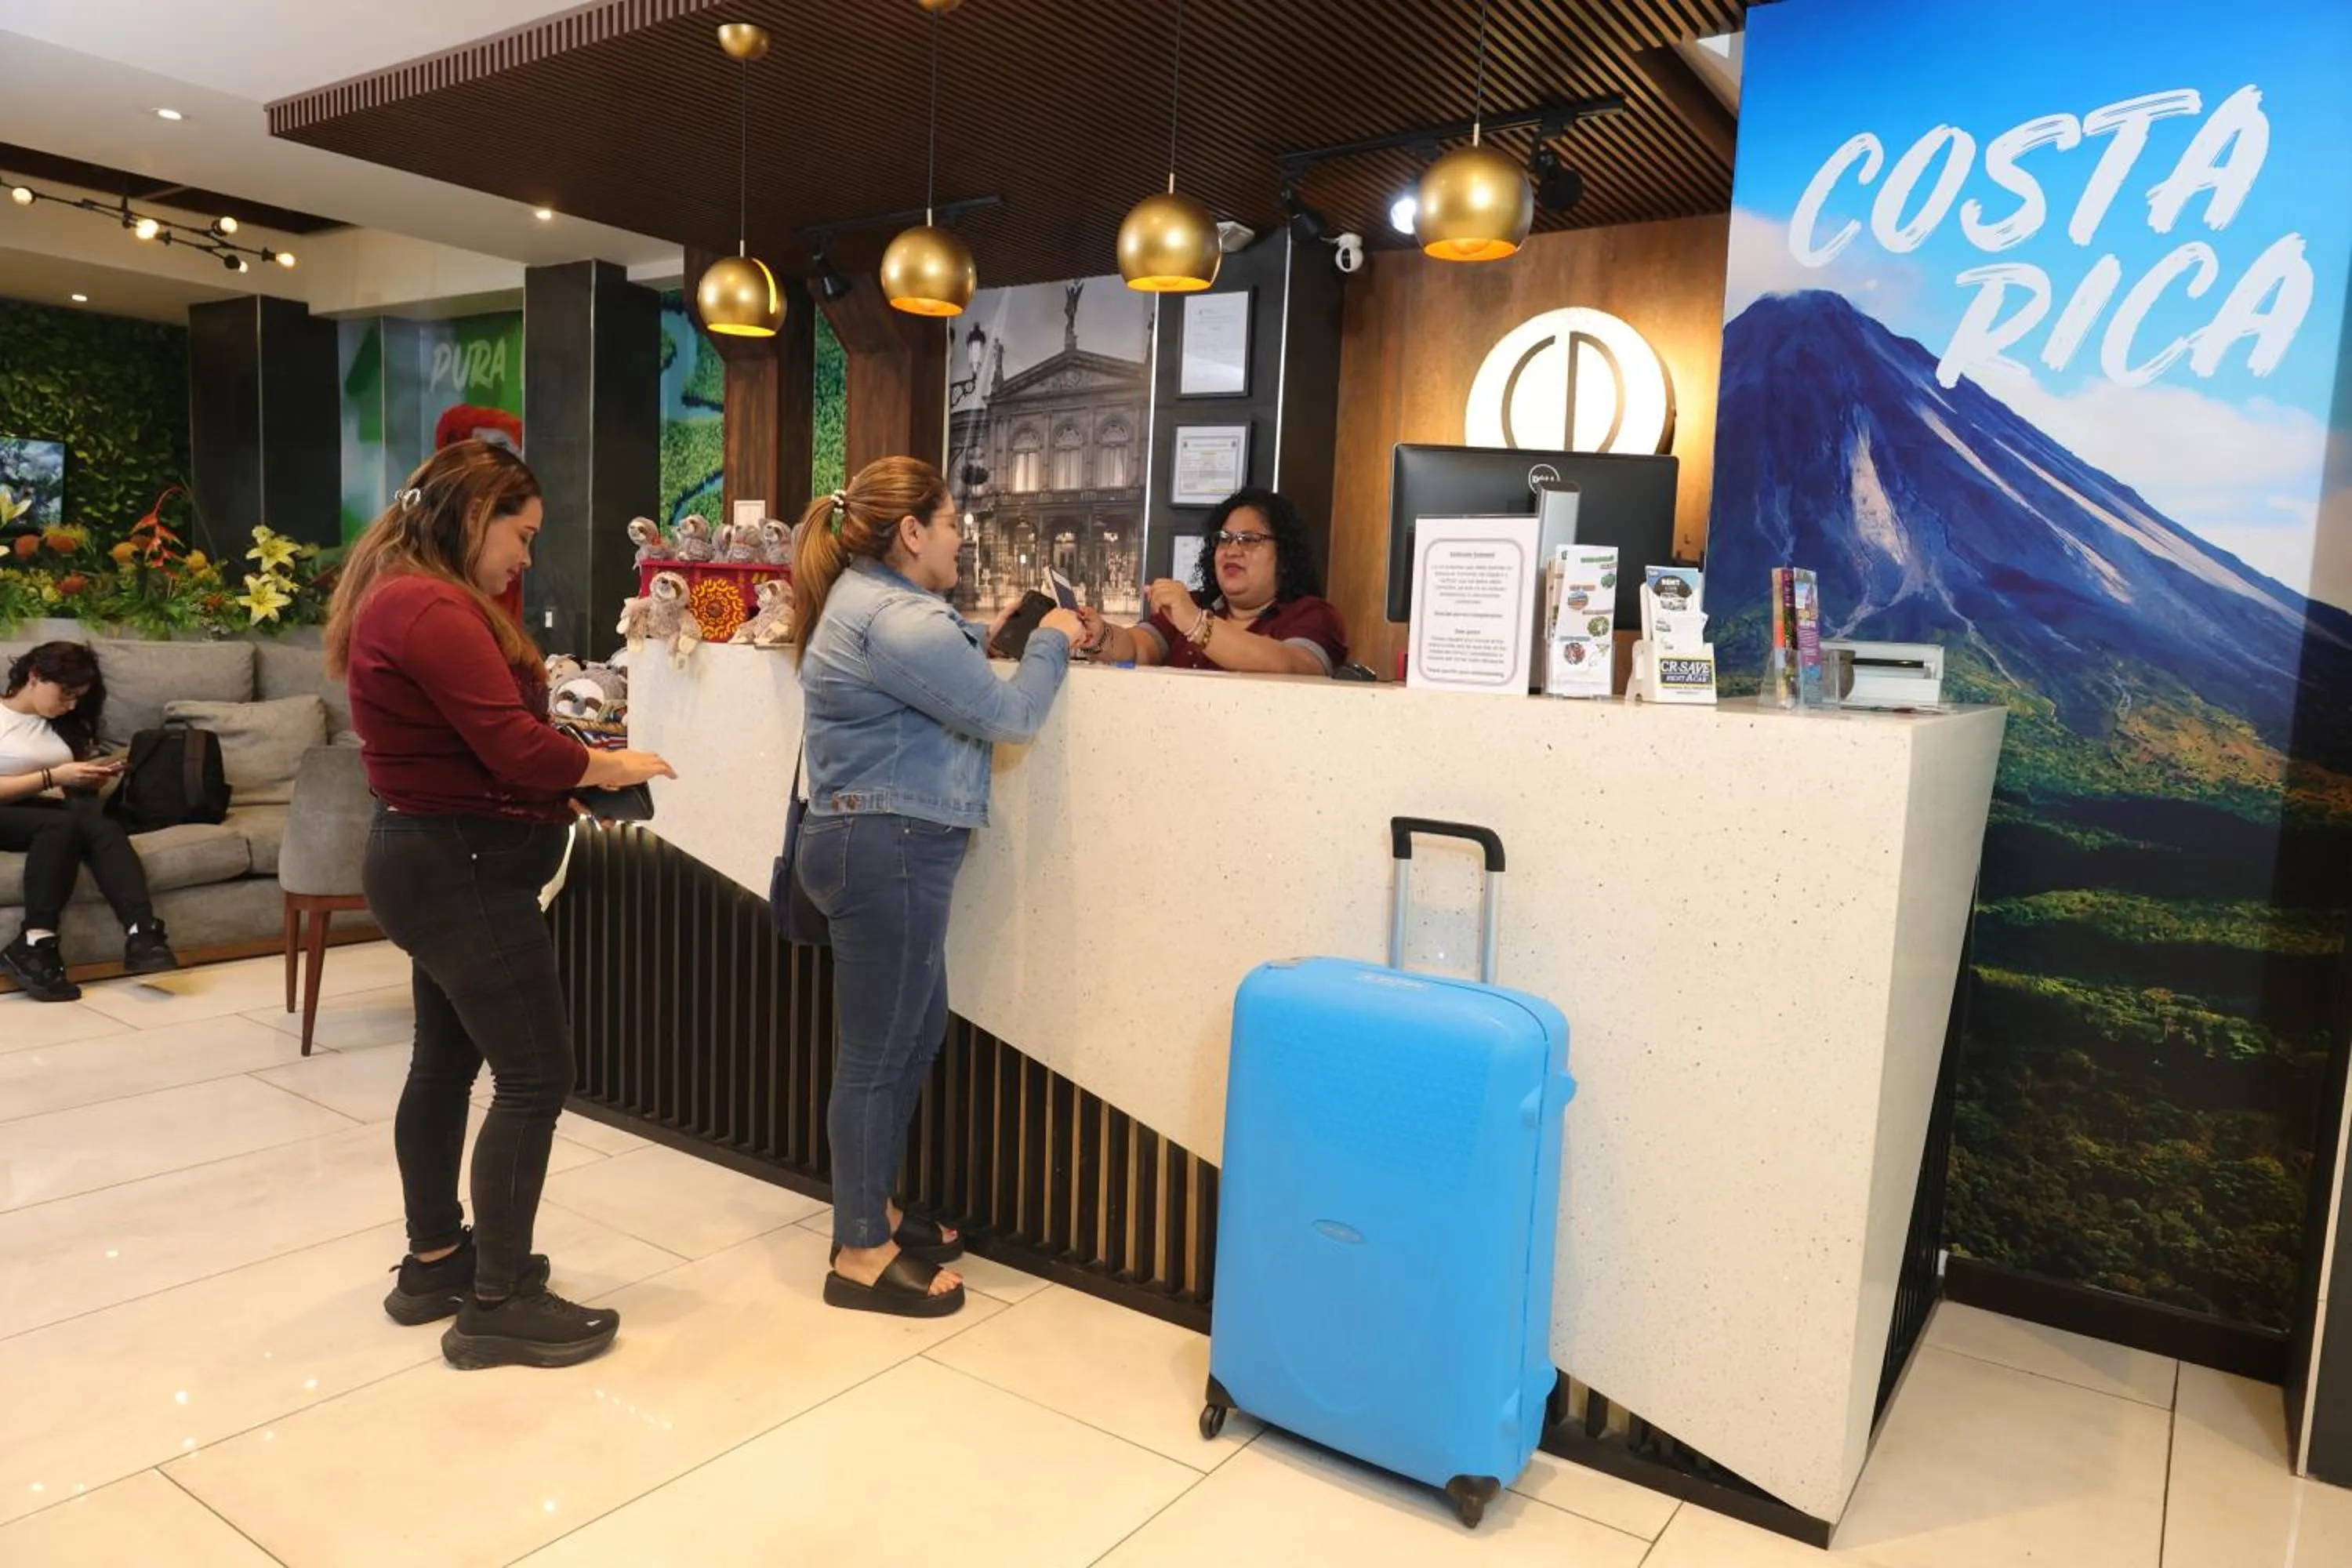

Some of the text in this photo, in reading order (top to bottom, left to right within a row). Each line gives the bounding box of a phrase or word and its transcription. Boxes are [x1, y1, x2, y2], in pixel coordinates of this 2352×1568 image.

[1788, 83, 2270, 267] COSTA
[429, 336, 506, 393] PURA
[1936, 231, 2314, 390] RICA
